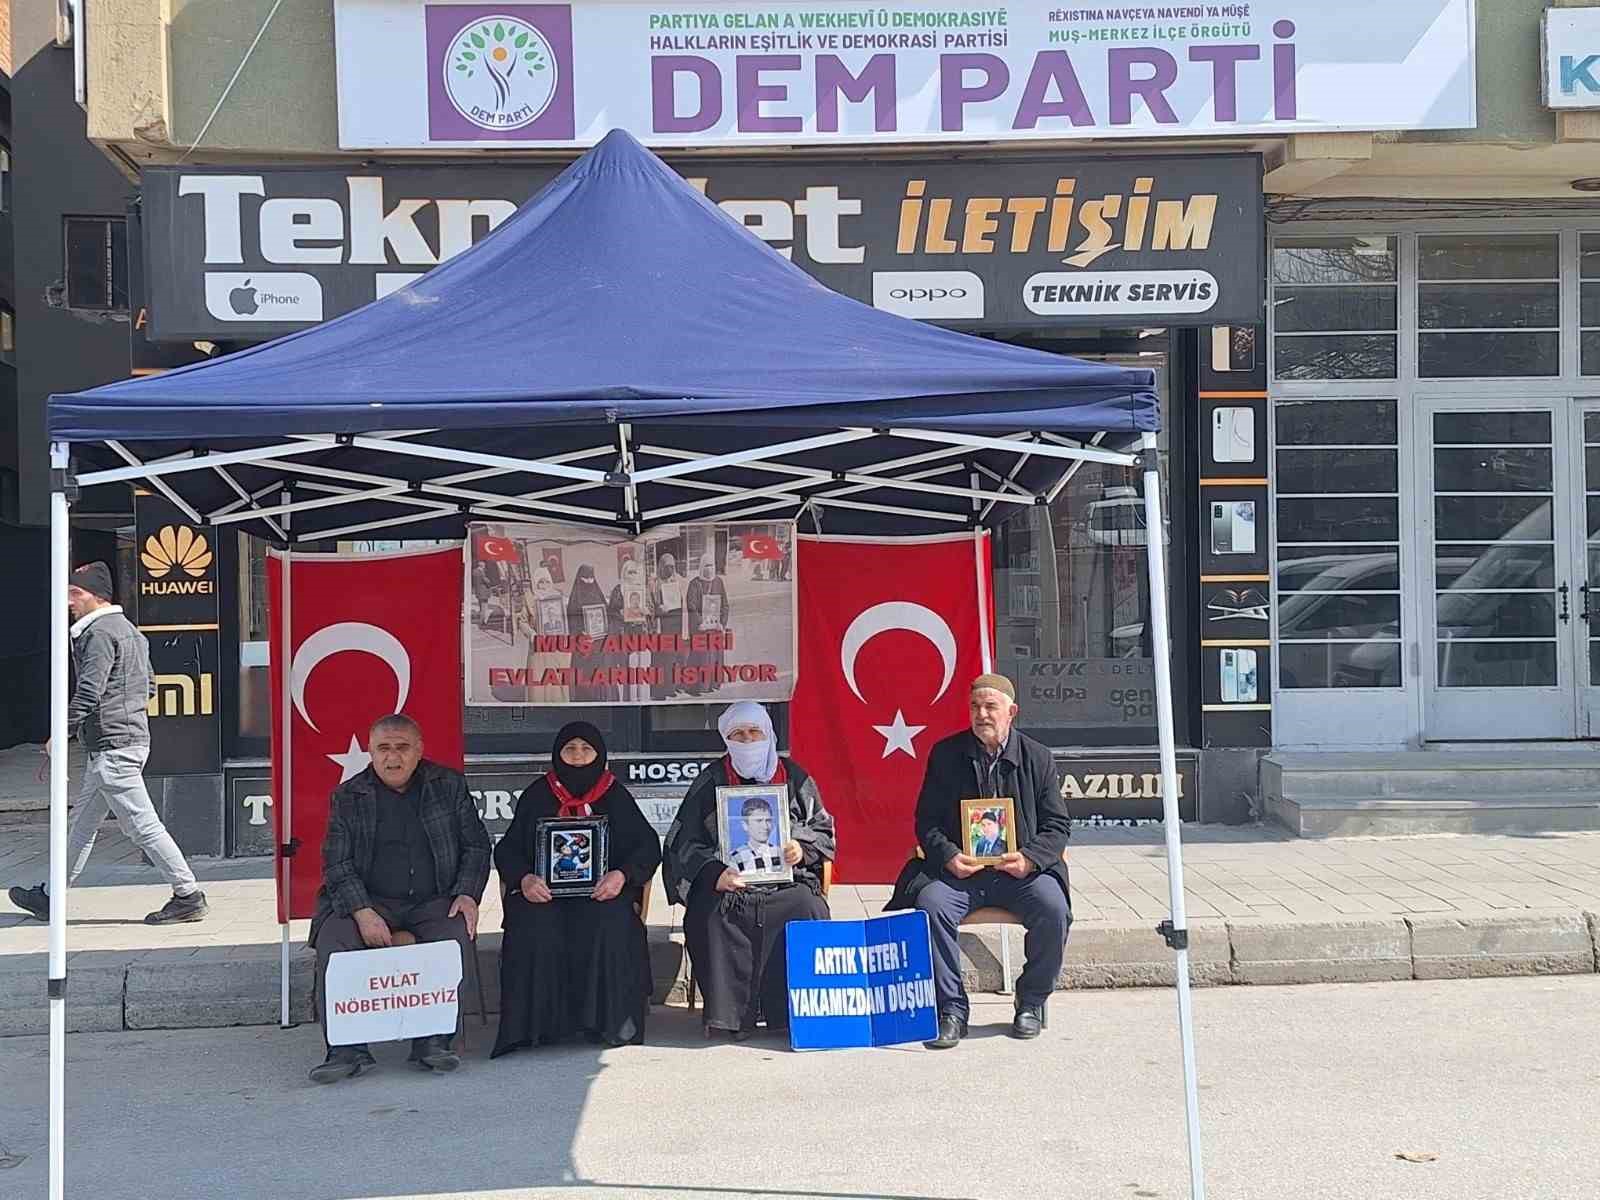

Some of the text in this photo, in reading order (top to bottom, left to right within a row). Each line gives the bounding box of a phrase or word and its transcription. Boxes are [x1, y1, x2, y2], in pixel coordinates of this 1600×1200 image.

[649, 14, 719, 29] PARTIYA
[723, 14, 778, 28] GELAN
[783, 14, 795, 28] A
[1106, 8, 1155, 21] NAVÇEYA
[1206, 6, 1220, 17] YA
[649, 29, 1008, 52] HALKLARIN EŞİTLİK VE DEMOKRASİ PARTİSİ
[1048, 22, 1251, 44] MUŞ-MERKEZ İLÇE ÖRGÜTÜ
[651, 19, 1297, 134] DEM PARTİ
[470, 105, 495, 123] DEM
[896, 177, 1218, 268] İLETİŞİM
[260, 293, 300, 305] iPhone
[1030, 277, 1212, 304] TEKNİK SERVİS
[141, 581, 213, 595] HUAWEI
[533, 629, 736, 657] MUŞ ANNELERİ
[488, 661, 778, 687] EVLATLARINI İSTİYOR
[1029, 663, 1087, 677] KVK
[1030, 683, 1088, 703] telpa
[628, 762, 711, 783] HOŞG
[814, 940, 908, 975] ARTIK YETER !
[369, 973, 420, 991] EVLAT
[334, 987, 457, 1015] NÖBETİNDEYİZ
[789, 972, 935, 1018] YAKAMIZDAN DÜŞÜN
